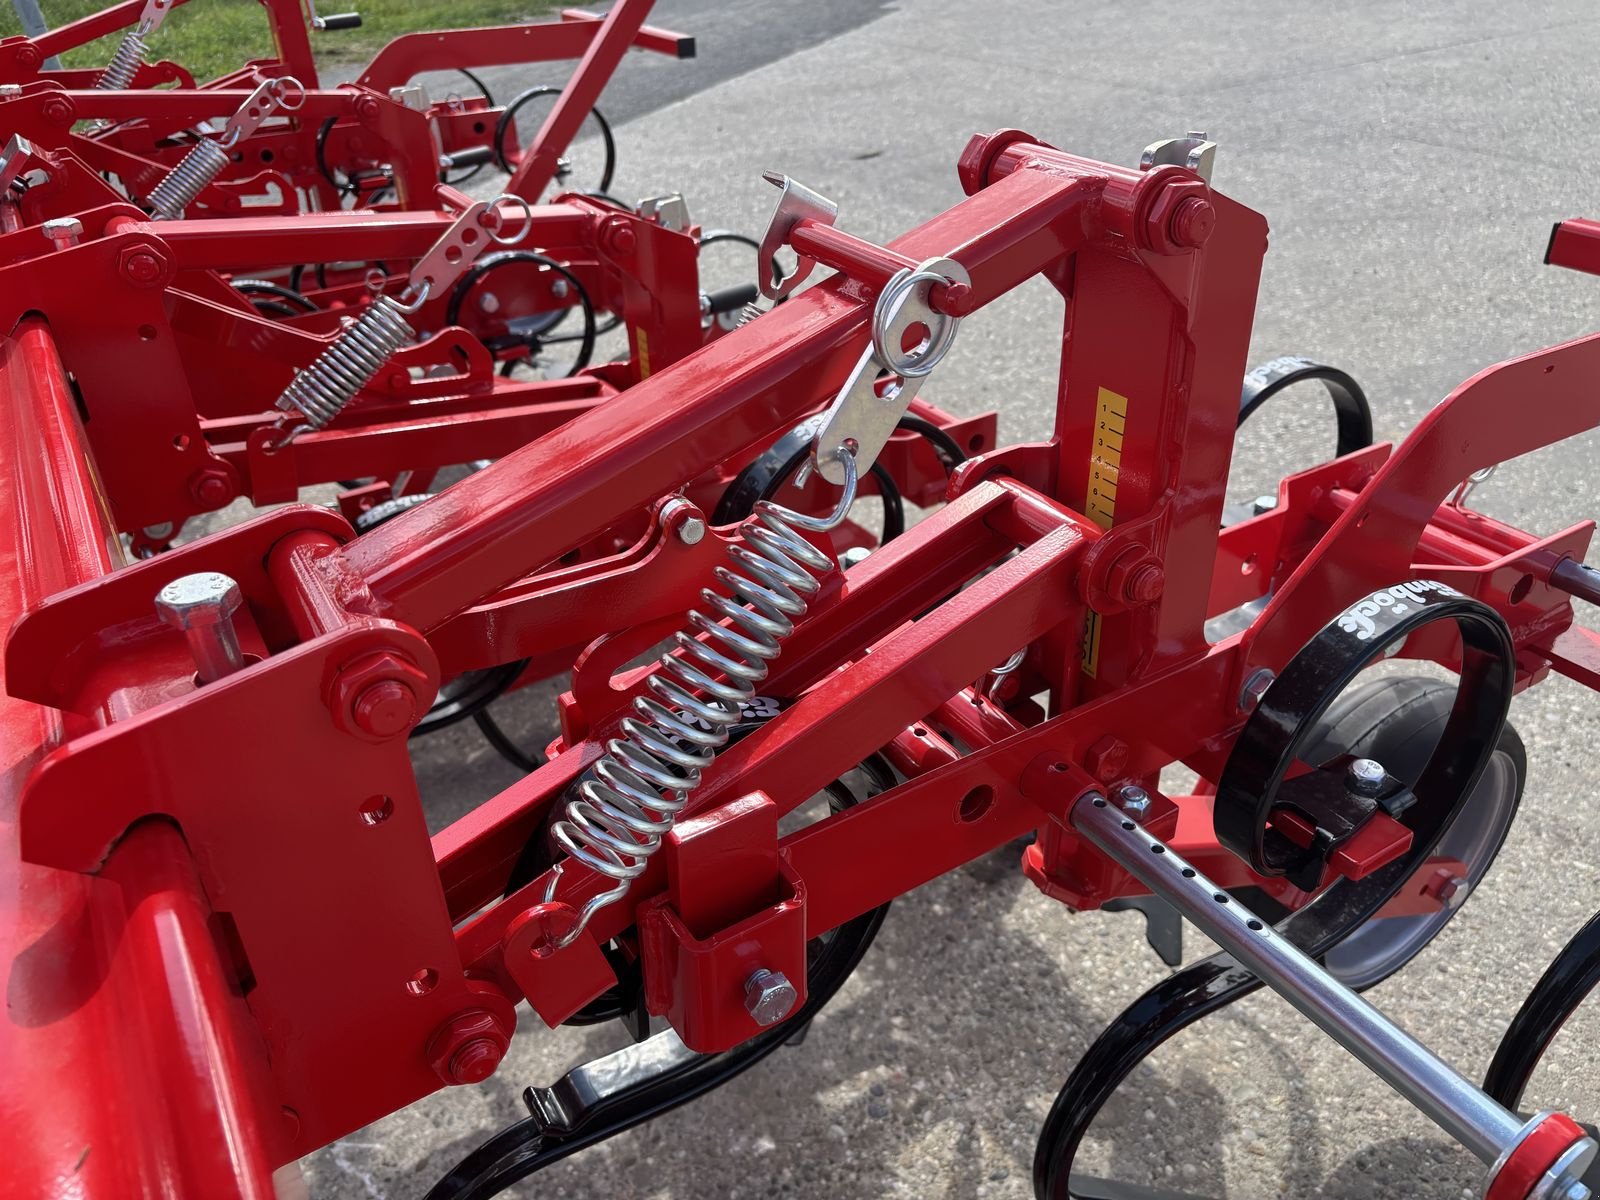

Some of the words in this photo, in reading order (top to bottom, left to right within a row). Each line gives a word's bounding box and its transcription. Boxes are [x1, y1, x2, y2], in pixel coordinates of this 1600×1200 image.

[1102, 404, 1107, 412] 1
[1100, 421, 1106, 430] 2
[1098, 438, 1103, 447] 3
[1096, 455, 1102, 464] 4
[1094, 471, 1100, 480] 5
[1092, 487, 1098, 496] 6
[1091, 502, 1096, 510] 7
